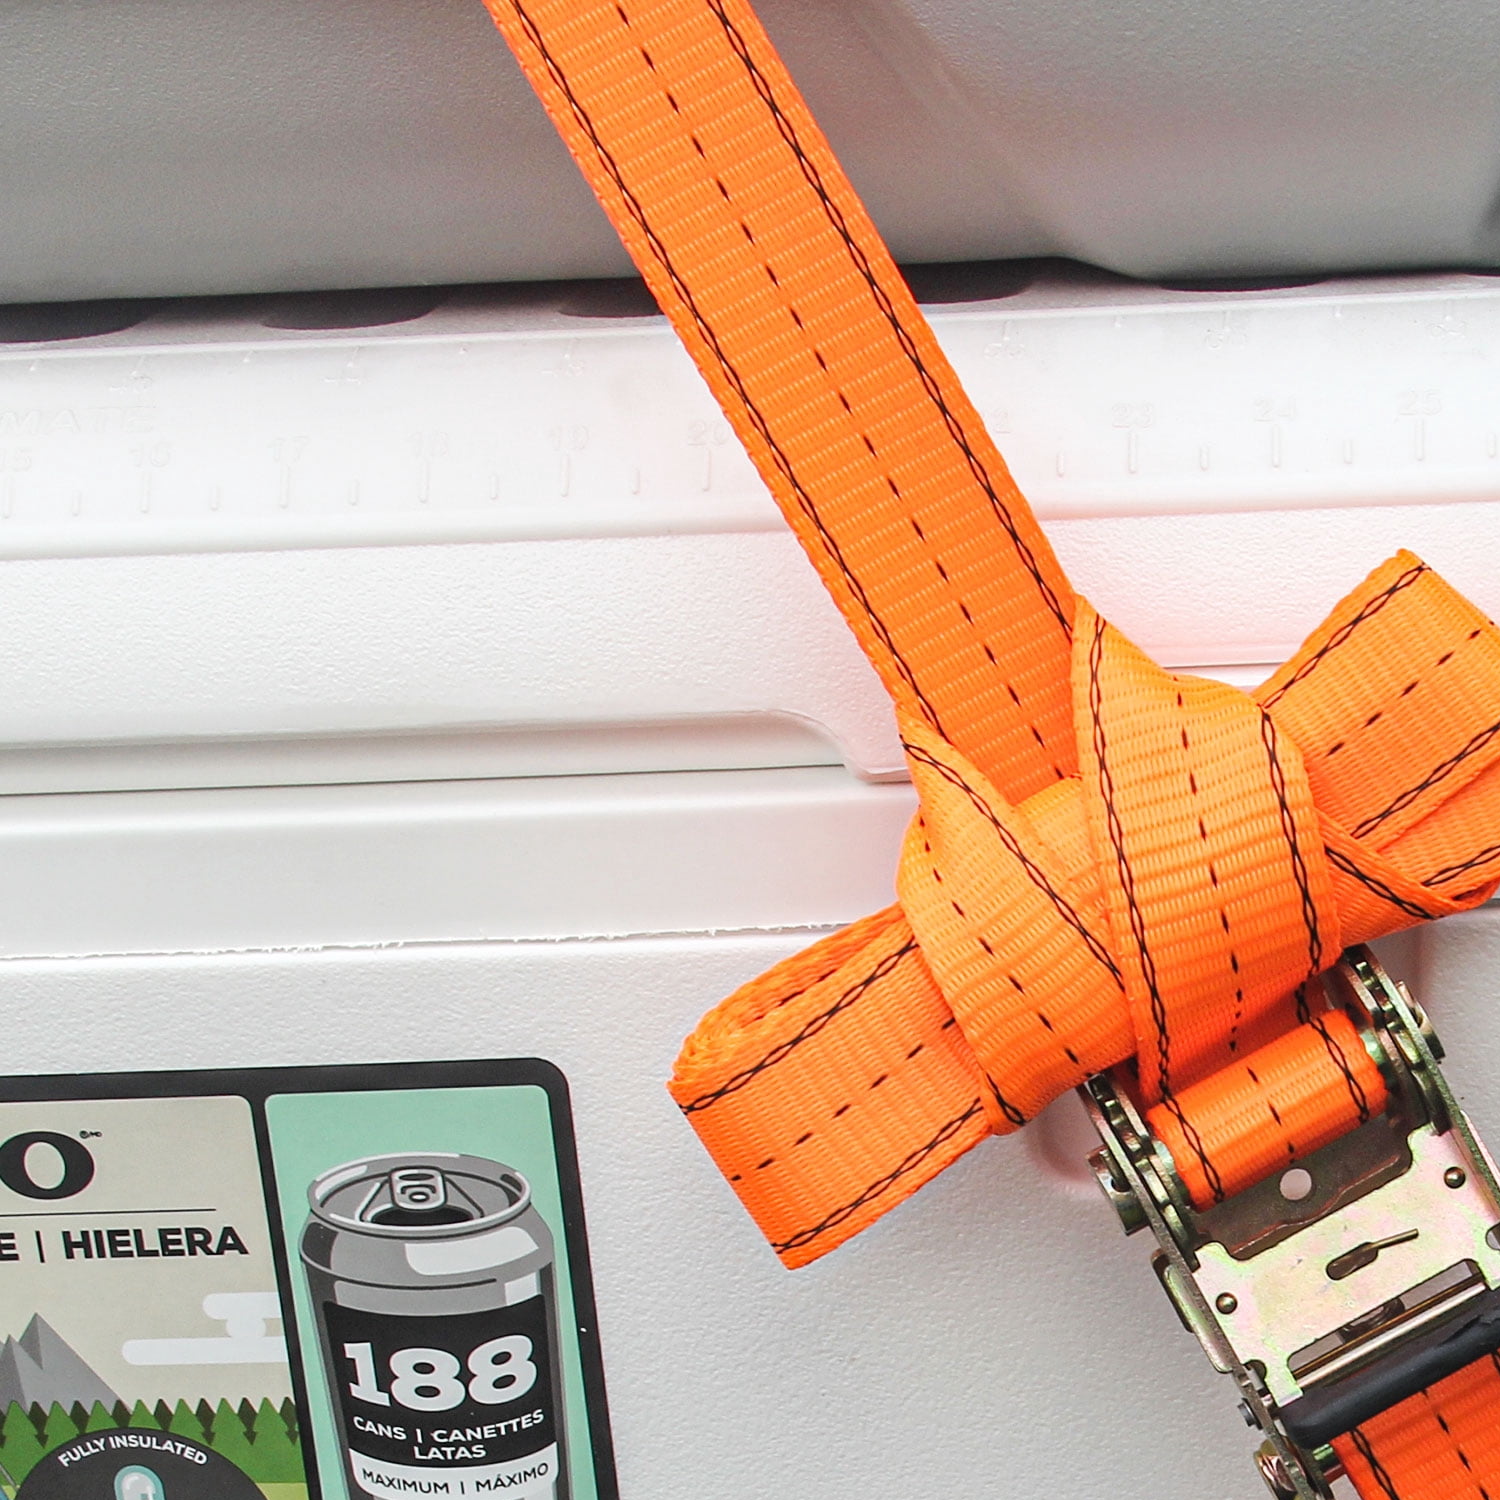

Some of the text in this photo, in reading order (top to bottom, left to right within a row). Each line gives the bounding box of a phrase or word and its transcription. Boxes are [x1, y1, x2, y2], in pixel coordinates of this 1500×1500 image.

[61, 1226, 250, 1260] HIELERA
[343, 1334, 538, 1412] 188
[353, 1409, 545, 1443] CANS CANETTES
[58, 1434, 208, 1467] FULLY INSULATED
[413, 1445, 487, 1461] LATAS
[362, 1462, 549, 1494] MAXIMUM MÁXIMO
